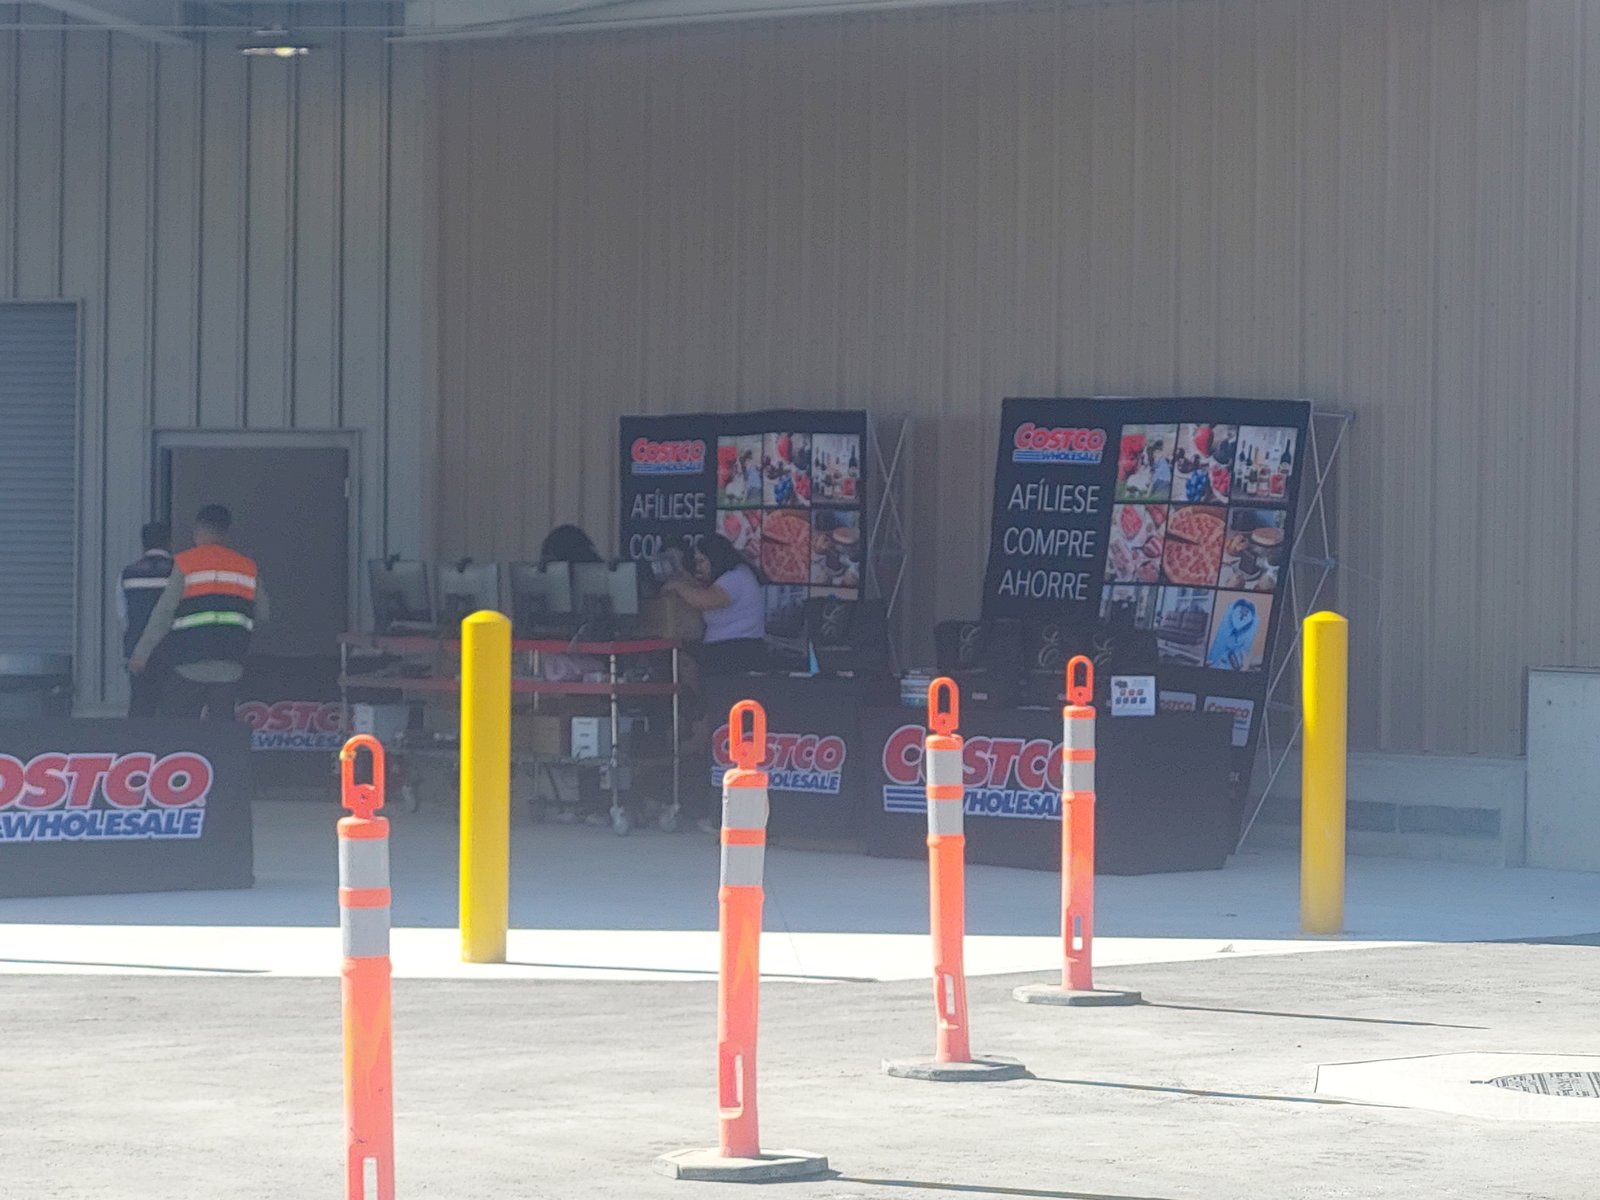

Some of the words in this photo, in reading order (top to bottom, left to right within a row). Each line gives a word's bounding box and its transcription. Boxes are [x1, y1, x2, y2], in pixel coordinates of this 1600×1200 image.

[632, 438, 706, 462] COSTCO
[1014, 423, 1106, 450] COSTCO
[631, 488, 706, 519] AFÍLIESE
[1007, 478, 1100, 514] AFÍLIESE
[1003, 527, 1097, 557] COMPRE
[998, 569, 1091, 600] AHORRE
